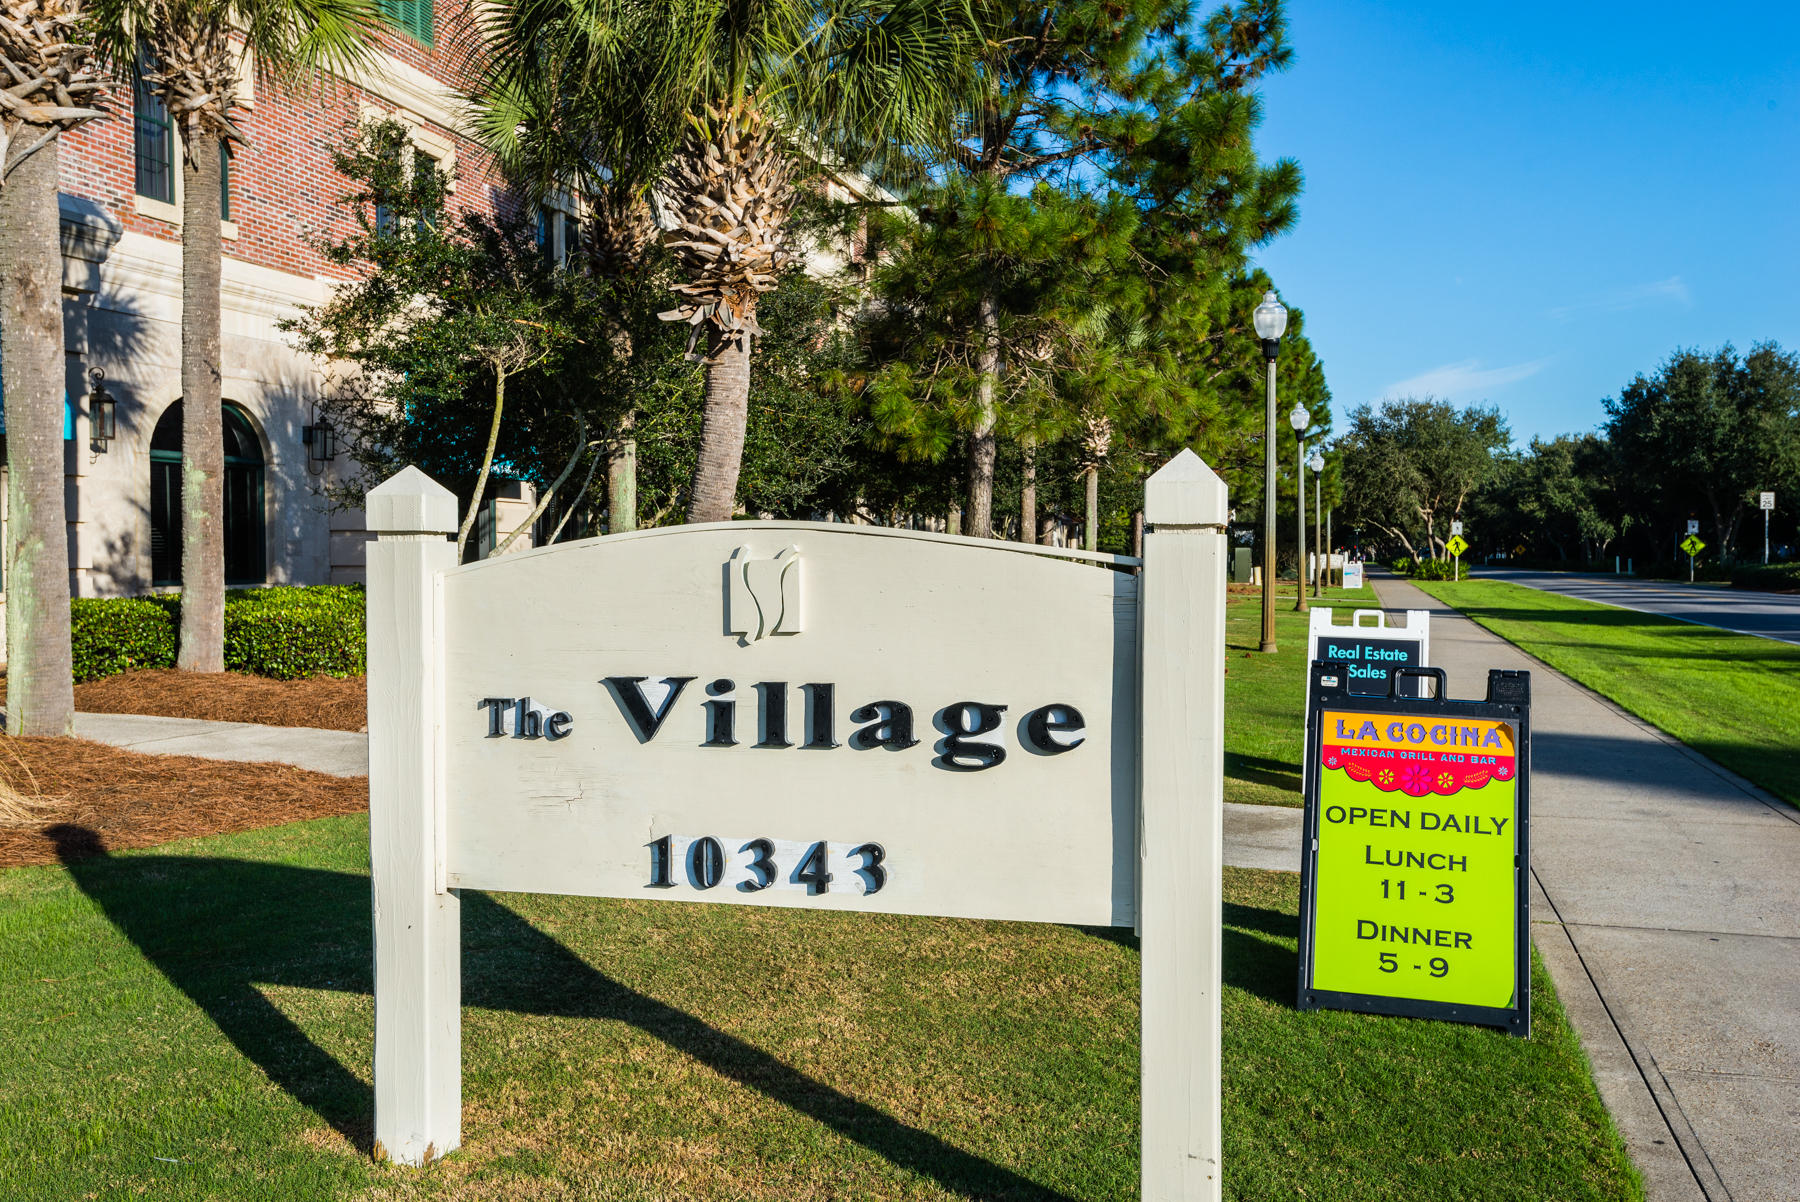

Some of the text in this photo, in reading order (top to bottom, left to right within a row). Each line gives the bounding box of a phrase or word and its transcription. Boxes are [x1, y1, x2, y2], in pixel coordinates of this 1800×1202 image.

[1328, 645, 1408, 662] Real Estate
[1349, 663, 1387, 680] Sales
[479, 676, 1086, 771] The Village
[1335, 719, 1503, 749] LA COCINA
[1340, 747, 1497, 765] MEXICAN GRILL AND BAR
[1325, 805, 1509, 836] OPEN DAILY
[646, 834, 888, 896] 10343
[1365, 845, 1468, 873] LUNCH
[1356, 919, 1473, 950] DINNER
